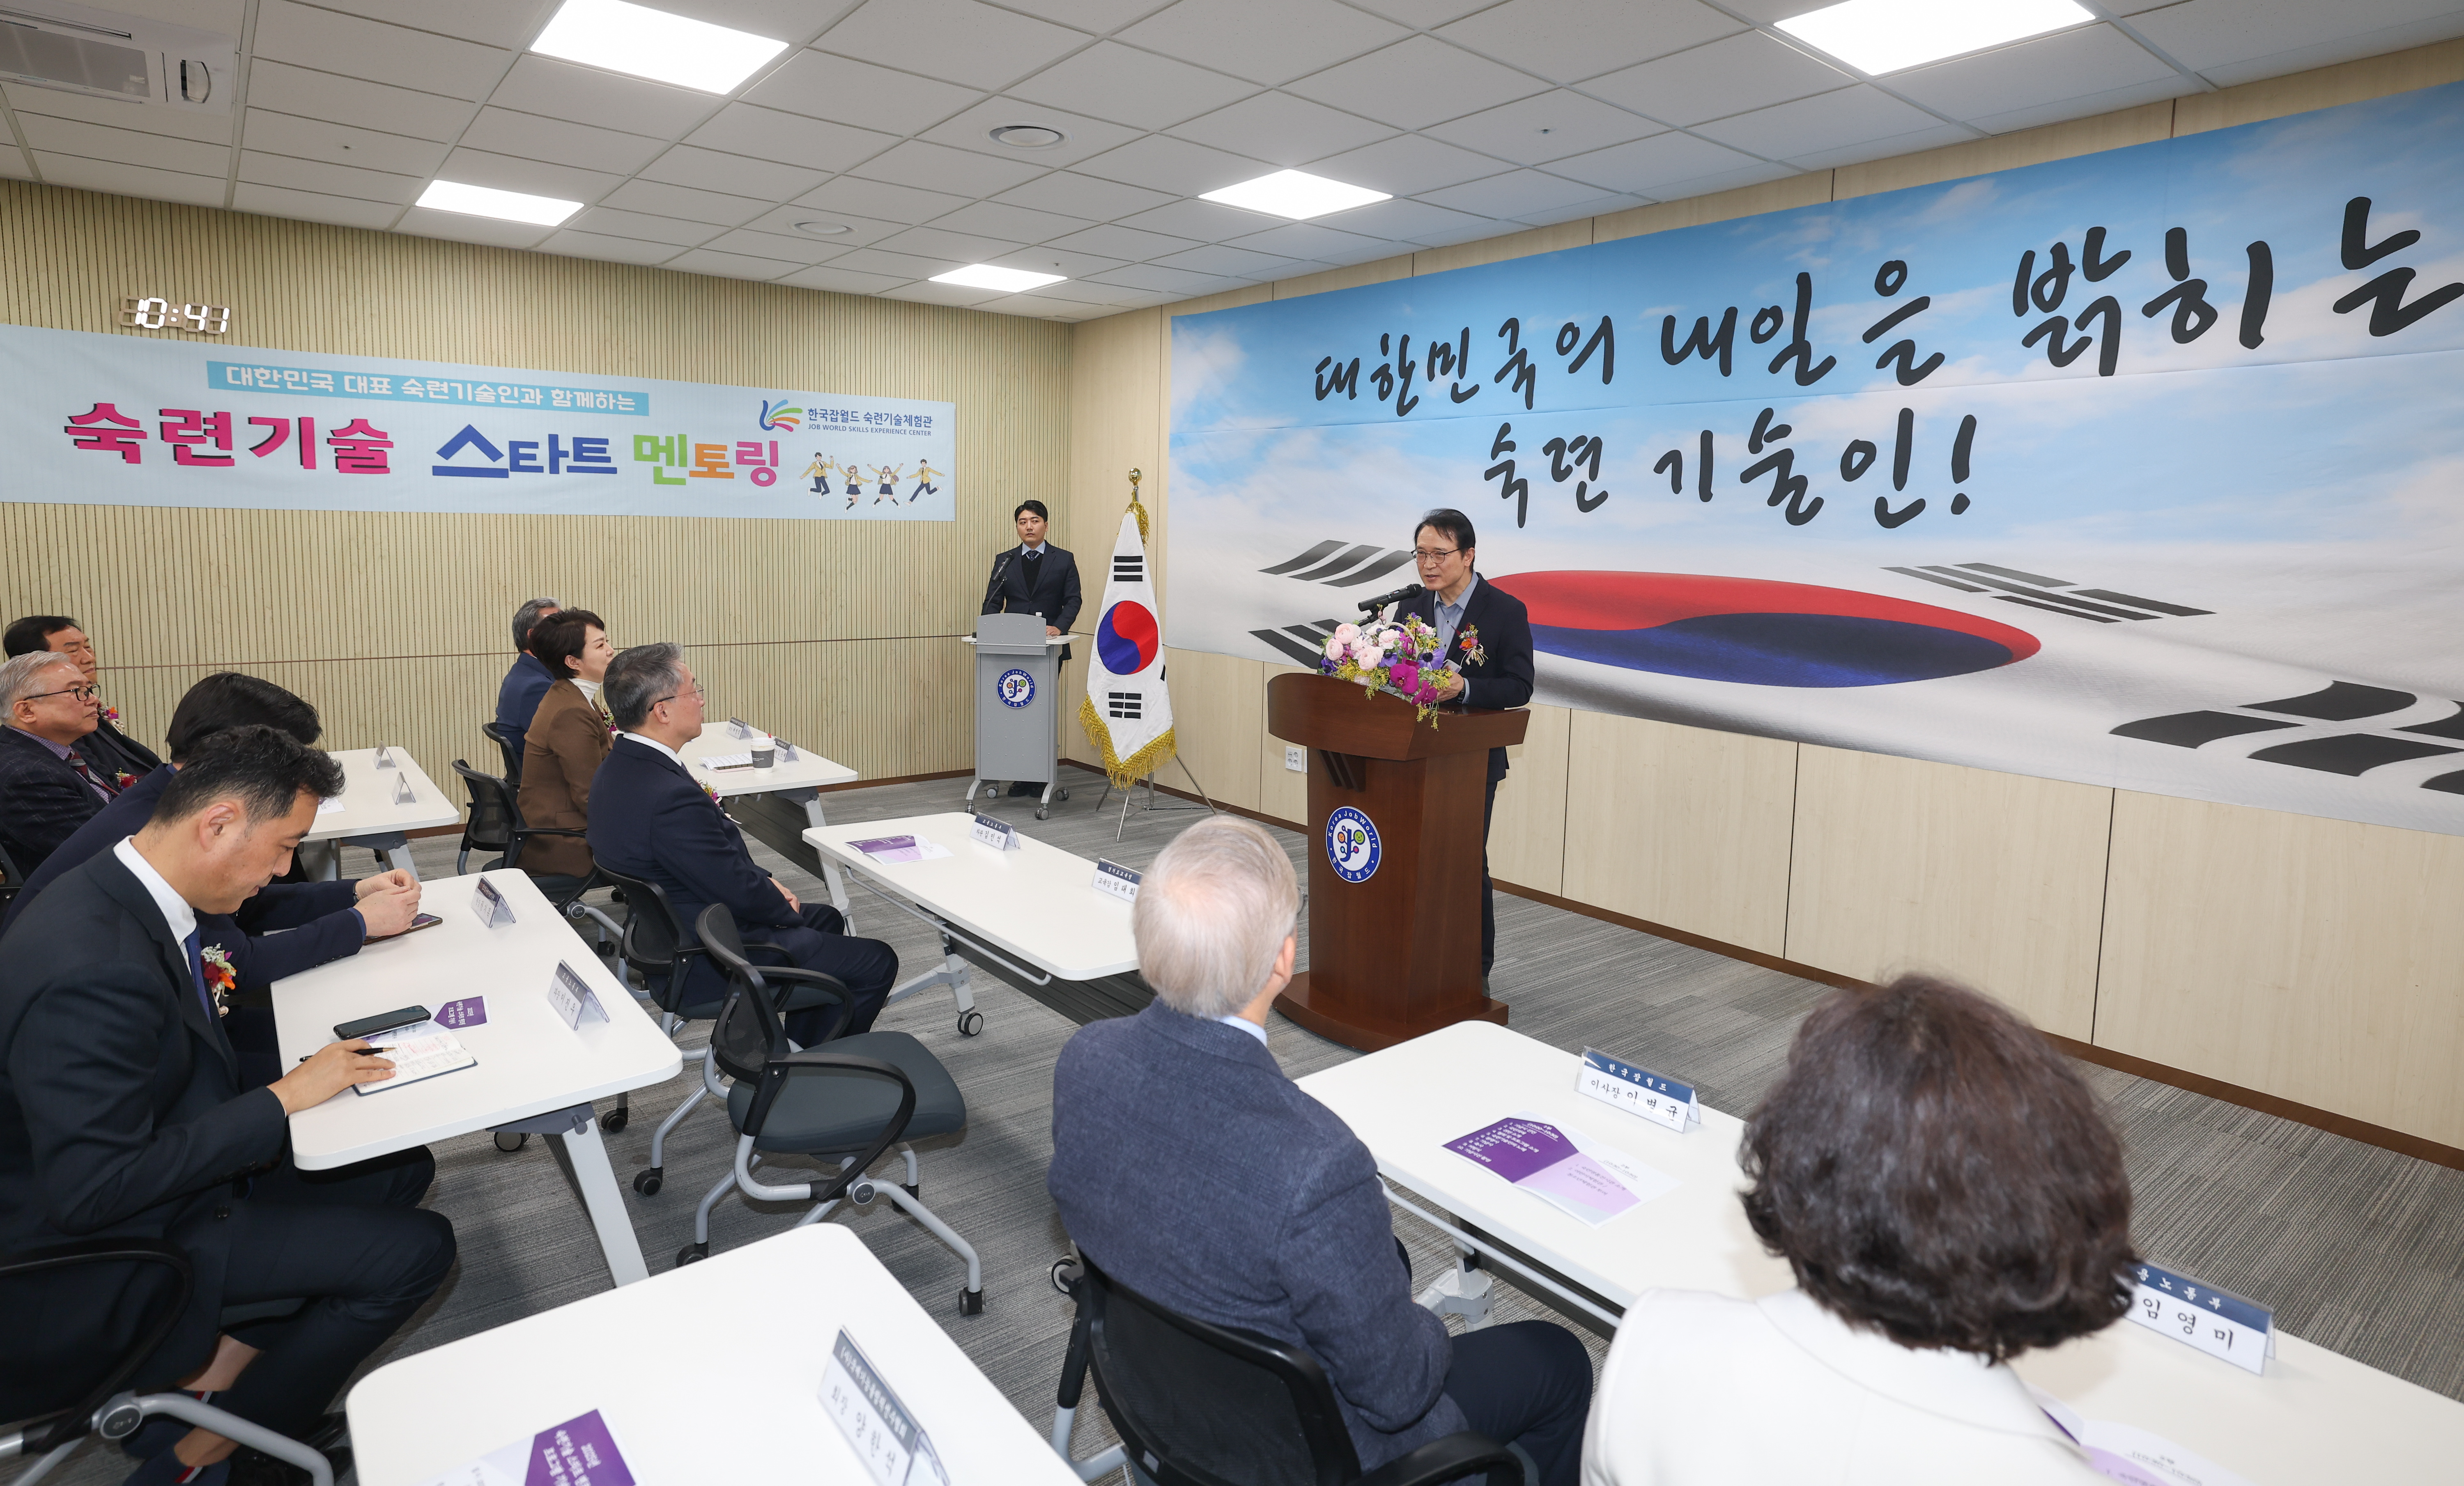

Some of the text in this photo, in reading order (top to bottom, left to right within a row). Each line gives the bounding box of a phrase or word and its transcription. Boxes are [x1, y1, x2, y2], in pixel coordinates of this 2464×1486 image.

[135, 297, 230, 333] 10:41
[1315, 197, 2464, 417] 대한민국의 내일을 밝히는
[226, 366, 636, 411] 대한민국 대표 숙련기술인과 함께하는
[808, 408, 933, 428] 한국잡월드 숙련기술체험관
[64, 403, 779, 487] 숙련기술 스타트 멘토링
[1484, 408, 1977, 529] 숙련 기술인!
[999, 673, 1010, 687] Korea
[1328, 813, 1342, 837] Korea
[1108, 866, 1132, 880] 경기도교육청
[1332, 857, 1370, 879] 한국잡월드
[1098, 878, 1135, 897] 교육감 임태희
[1591, 1079, 1620, 1099] 이사장
[1609, 1063, 1666, 1091] 한국잡월드
[2137, 1268, 2220, 1310] 용노동부
[2144, 1298, 2233, 1351] 임영미
